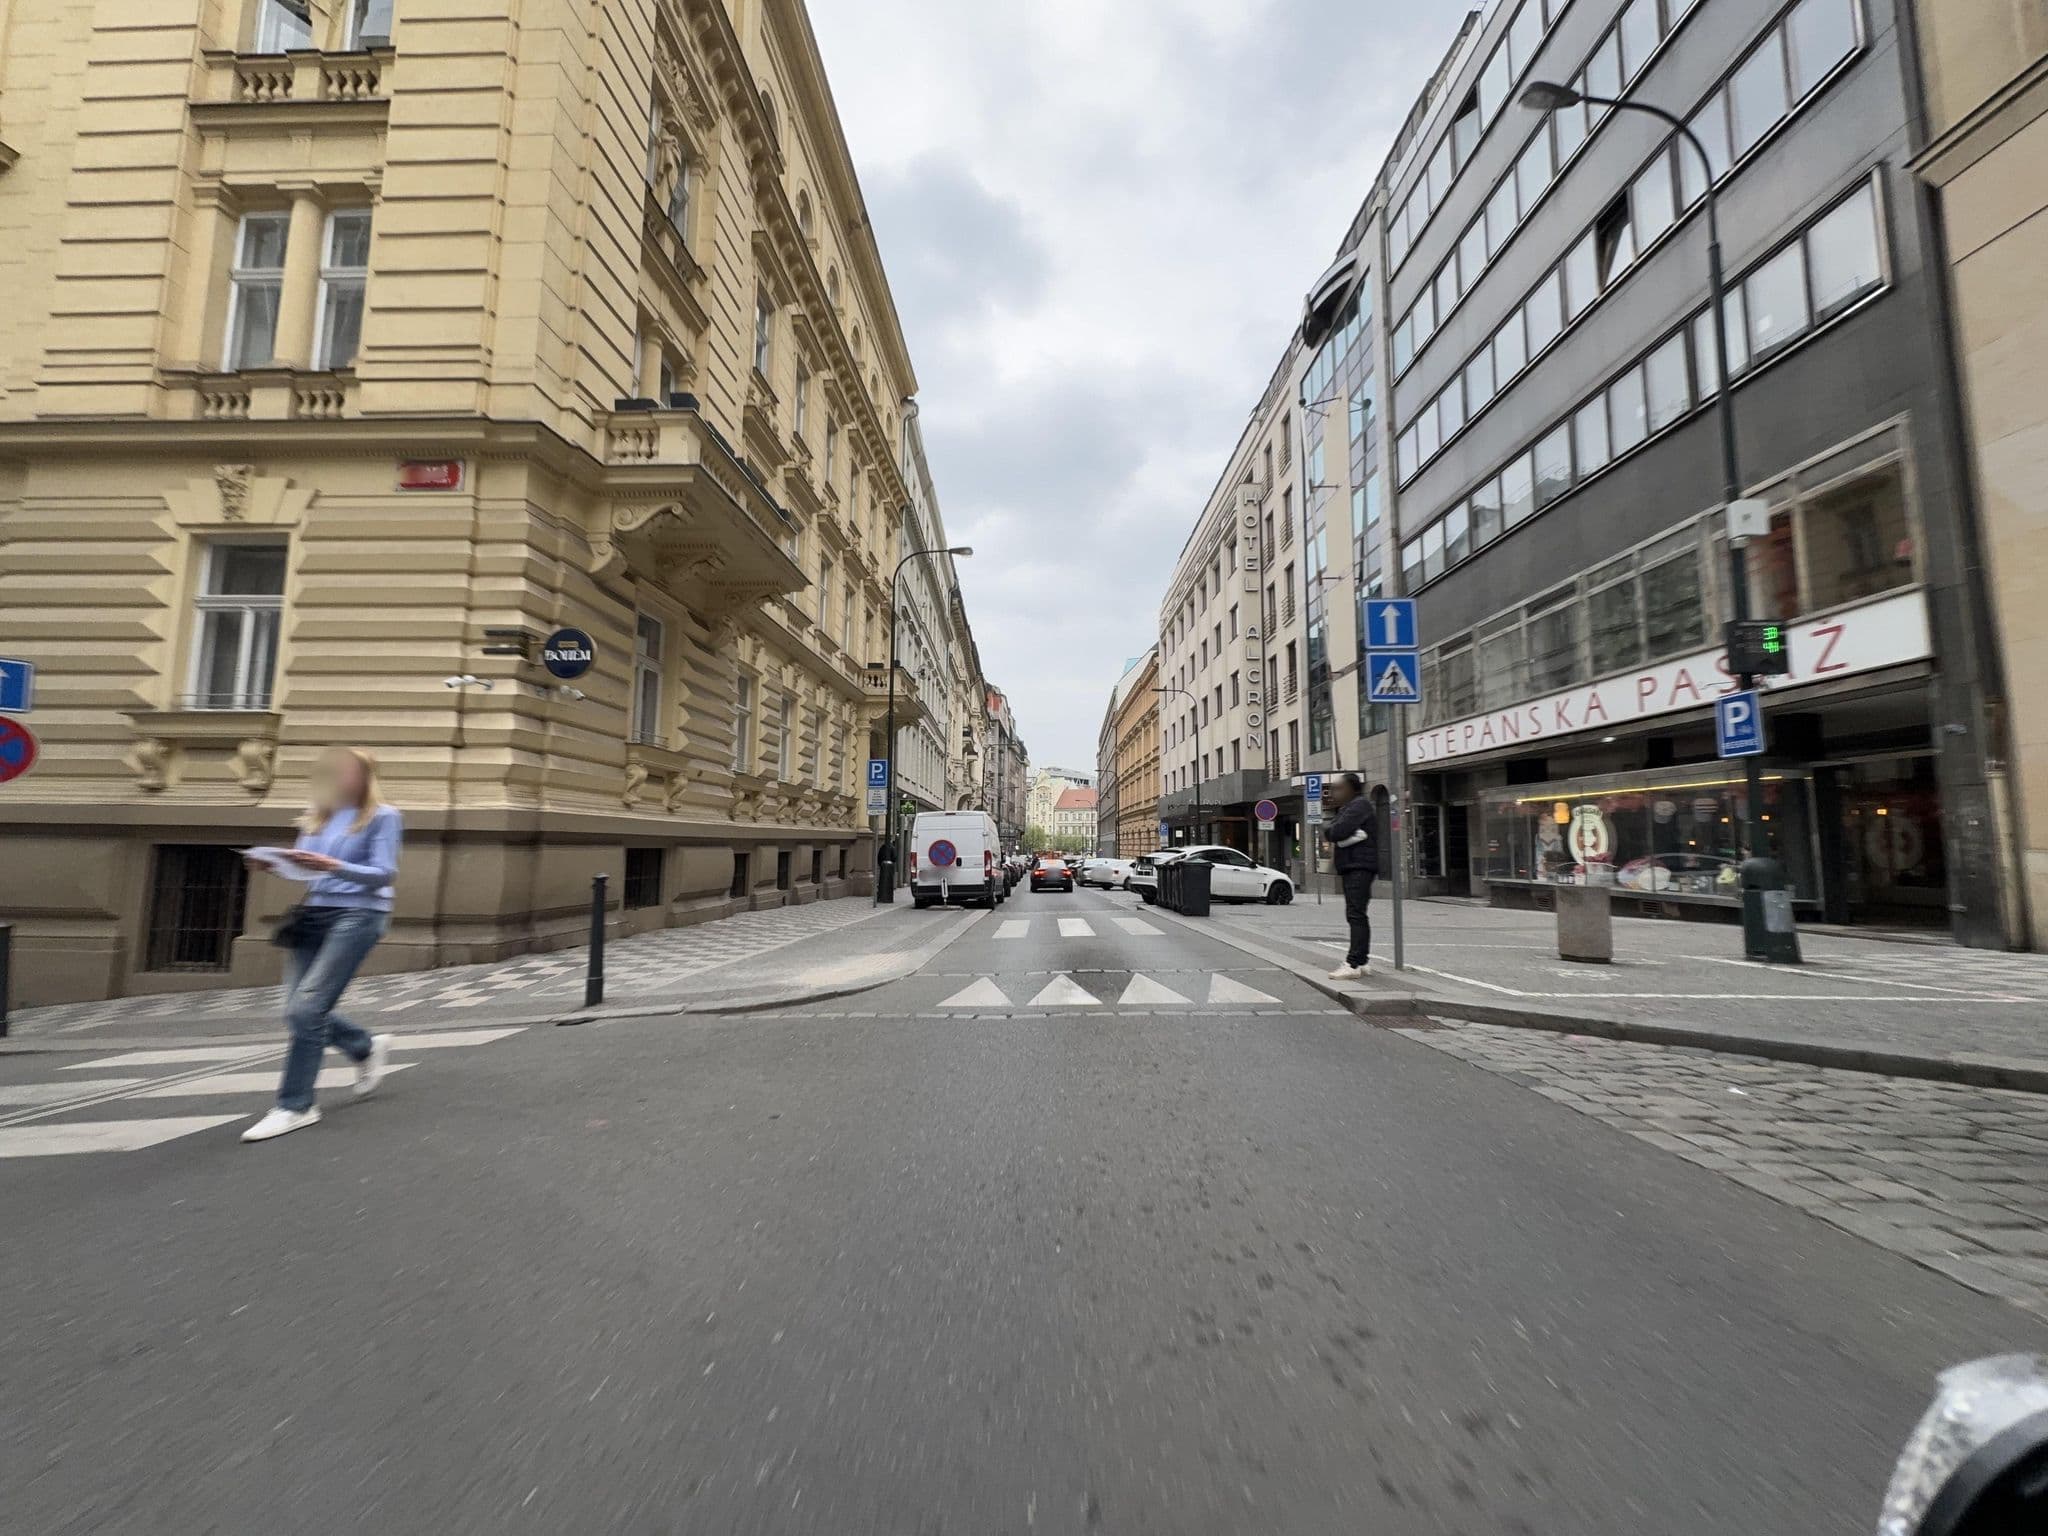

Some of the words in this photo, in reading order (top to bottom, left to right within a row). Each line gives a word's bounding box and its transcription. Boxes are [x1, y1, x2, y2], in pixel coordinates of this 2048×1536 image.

[1242, 491, 1260, 593] HOTEL
[1245, 624, 1263, 749] ALCRON
[1635, 620, 1850, 713] PASŽ
[1723, 701, 1751, 738] P
[871, 762, 883, 779] P
[1308, 778, 1318, 793] P
